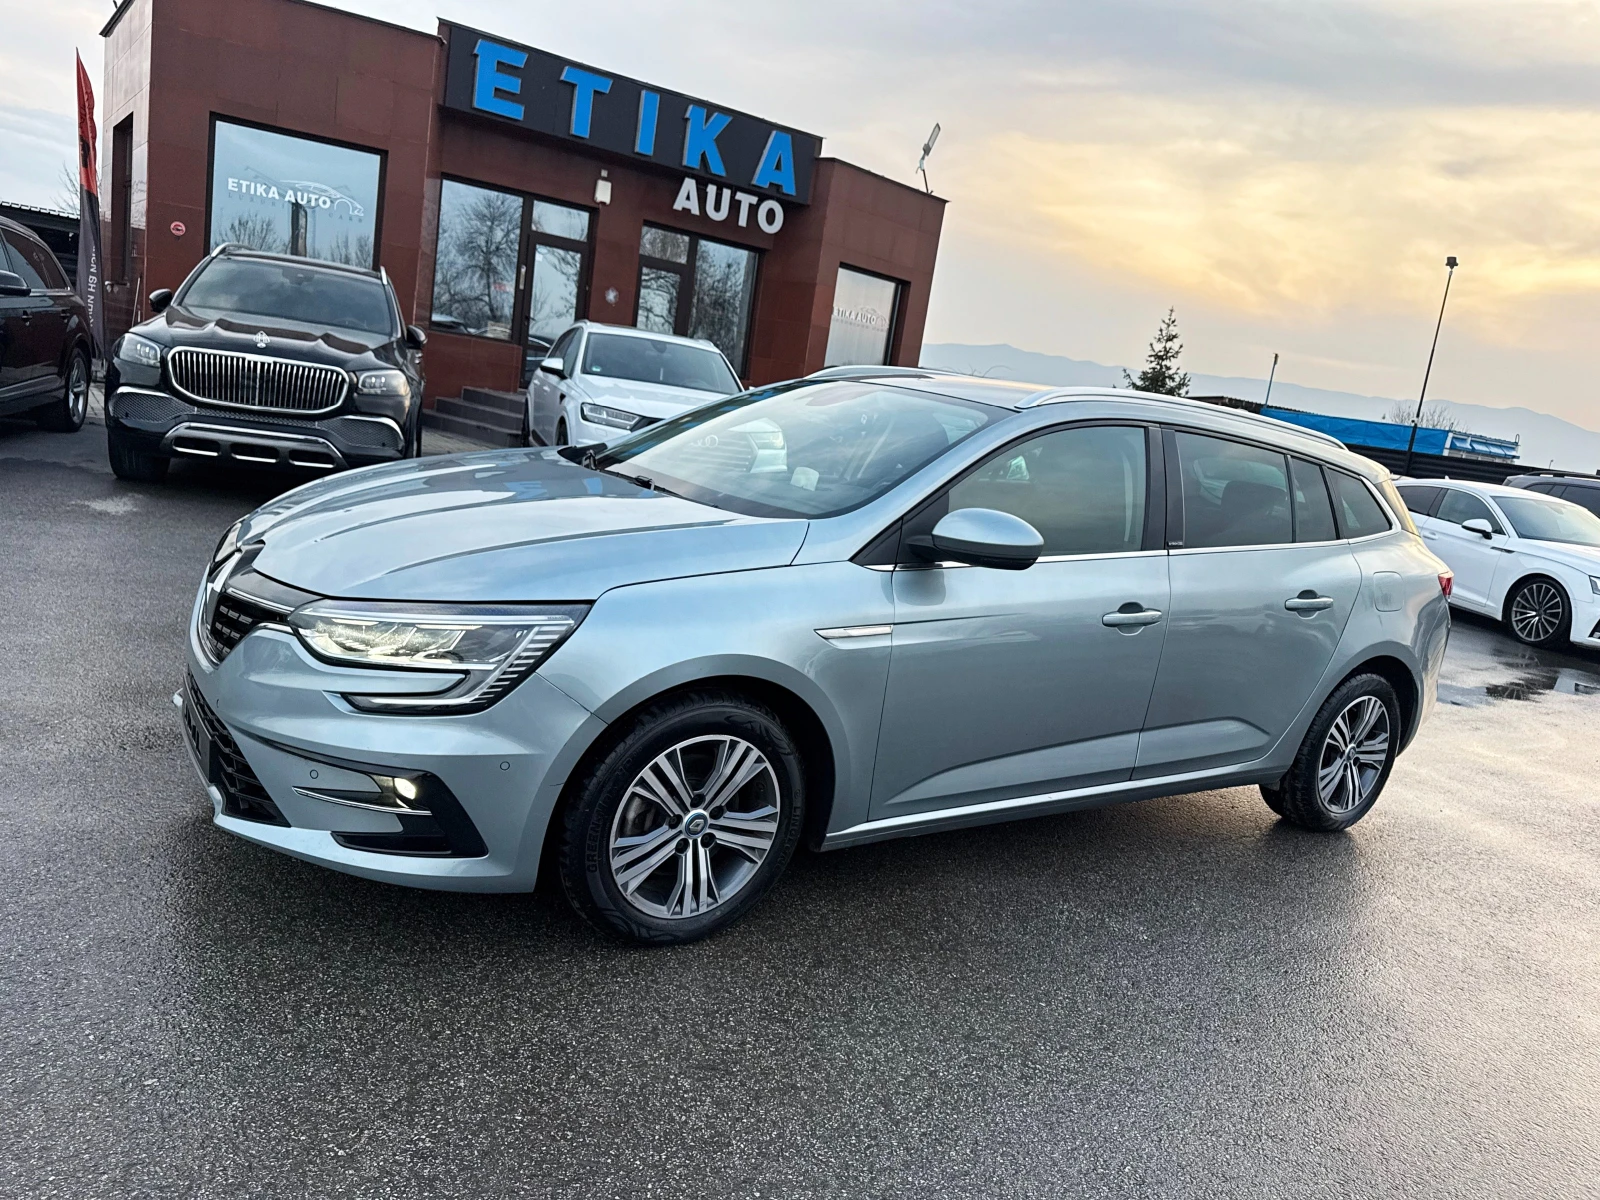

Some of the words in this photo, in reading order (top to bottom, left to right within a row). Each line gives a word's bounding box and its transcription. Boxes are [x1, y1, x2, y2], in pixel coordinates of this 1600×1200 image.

[473, 39, 797, 197] ETIKA
[227, 177, 280, 200] ETIKA
[284, 189, 331, 210] AUTO
[672, 177, 784, 235] AUTO
[854, 312, 877, 325] AUTO
